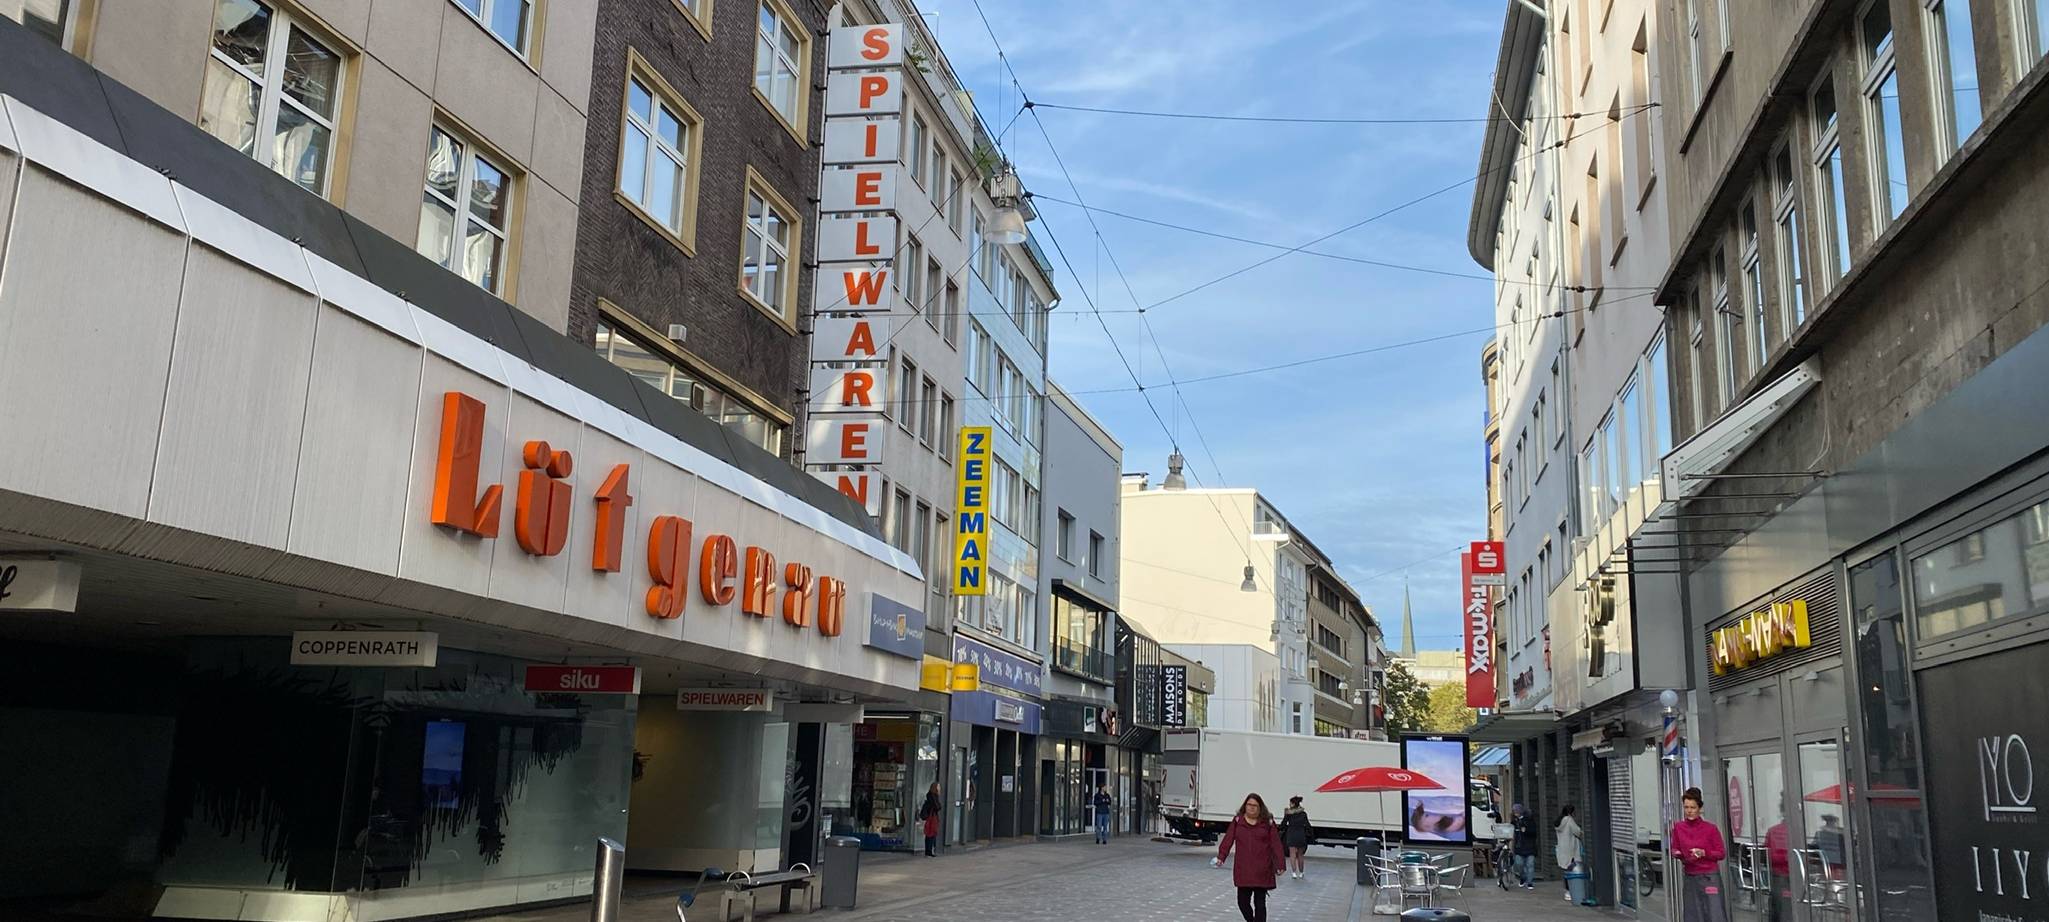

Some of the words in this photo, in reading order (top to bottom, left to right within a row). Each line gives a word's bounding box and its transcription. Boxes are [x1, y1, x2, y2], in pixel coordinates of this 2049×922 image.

[838, 27, 890, 505] SPIELWAREN
[431, 391, 847, 637] Lütgenau
[959, 433, 984, 588] ZEEMAN
[299, 640, 419, 655] COPPENRATH
[559, 670, 600, 689] siku
[681, 692, 764, 706] SPIELWAREN
[1165, 667, 1175, 723] MAISONS
[1972, 846, 2049, 899] IIY
